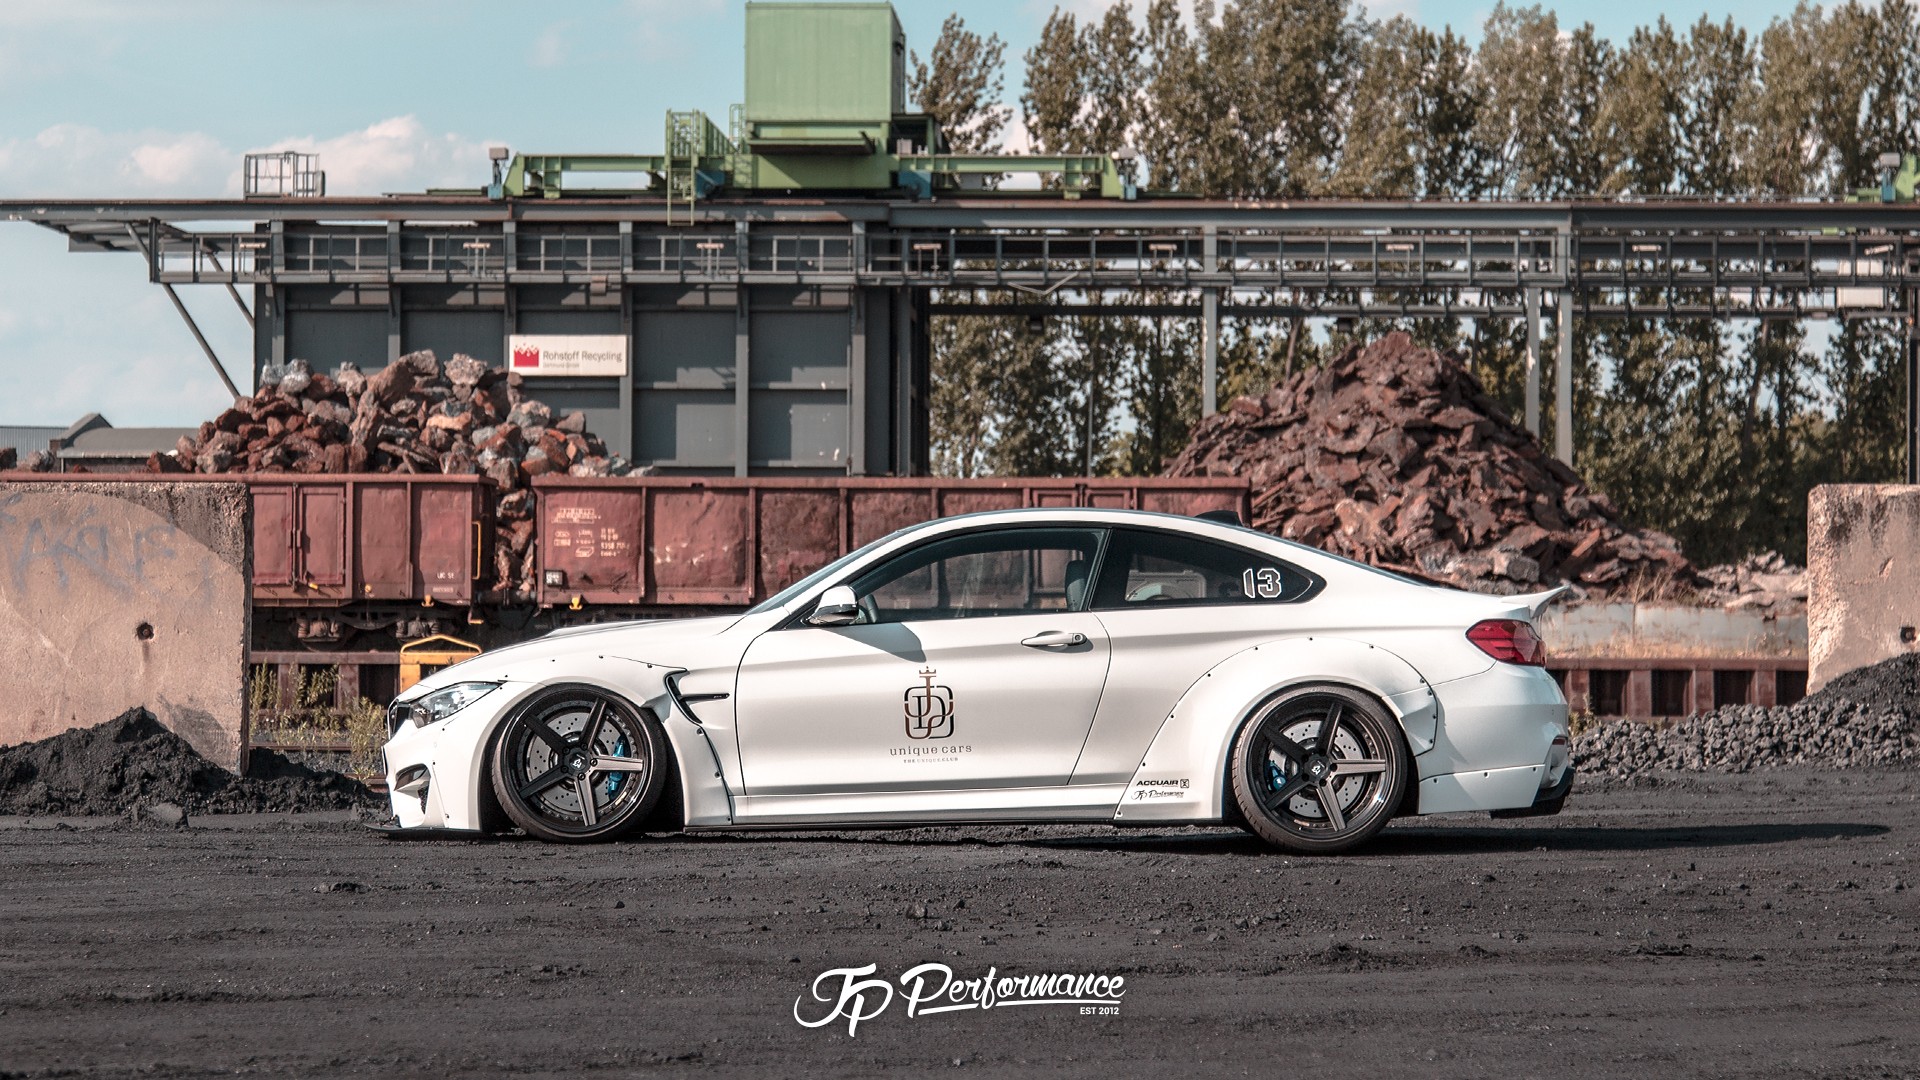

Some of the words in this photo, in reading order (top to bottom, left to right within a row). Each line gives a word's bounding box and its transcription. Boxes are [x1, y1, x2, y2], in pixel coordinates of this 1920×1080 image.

[542, 350, 580, 361] Rohstoff
[581, 351, 623, 363] Recycling
[1242, 567, 1282, 599] 13
[889, 745, 938, 756] unique
[941, 744, 972, 754] cars
